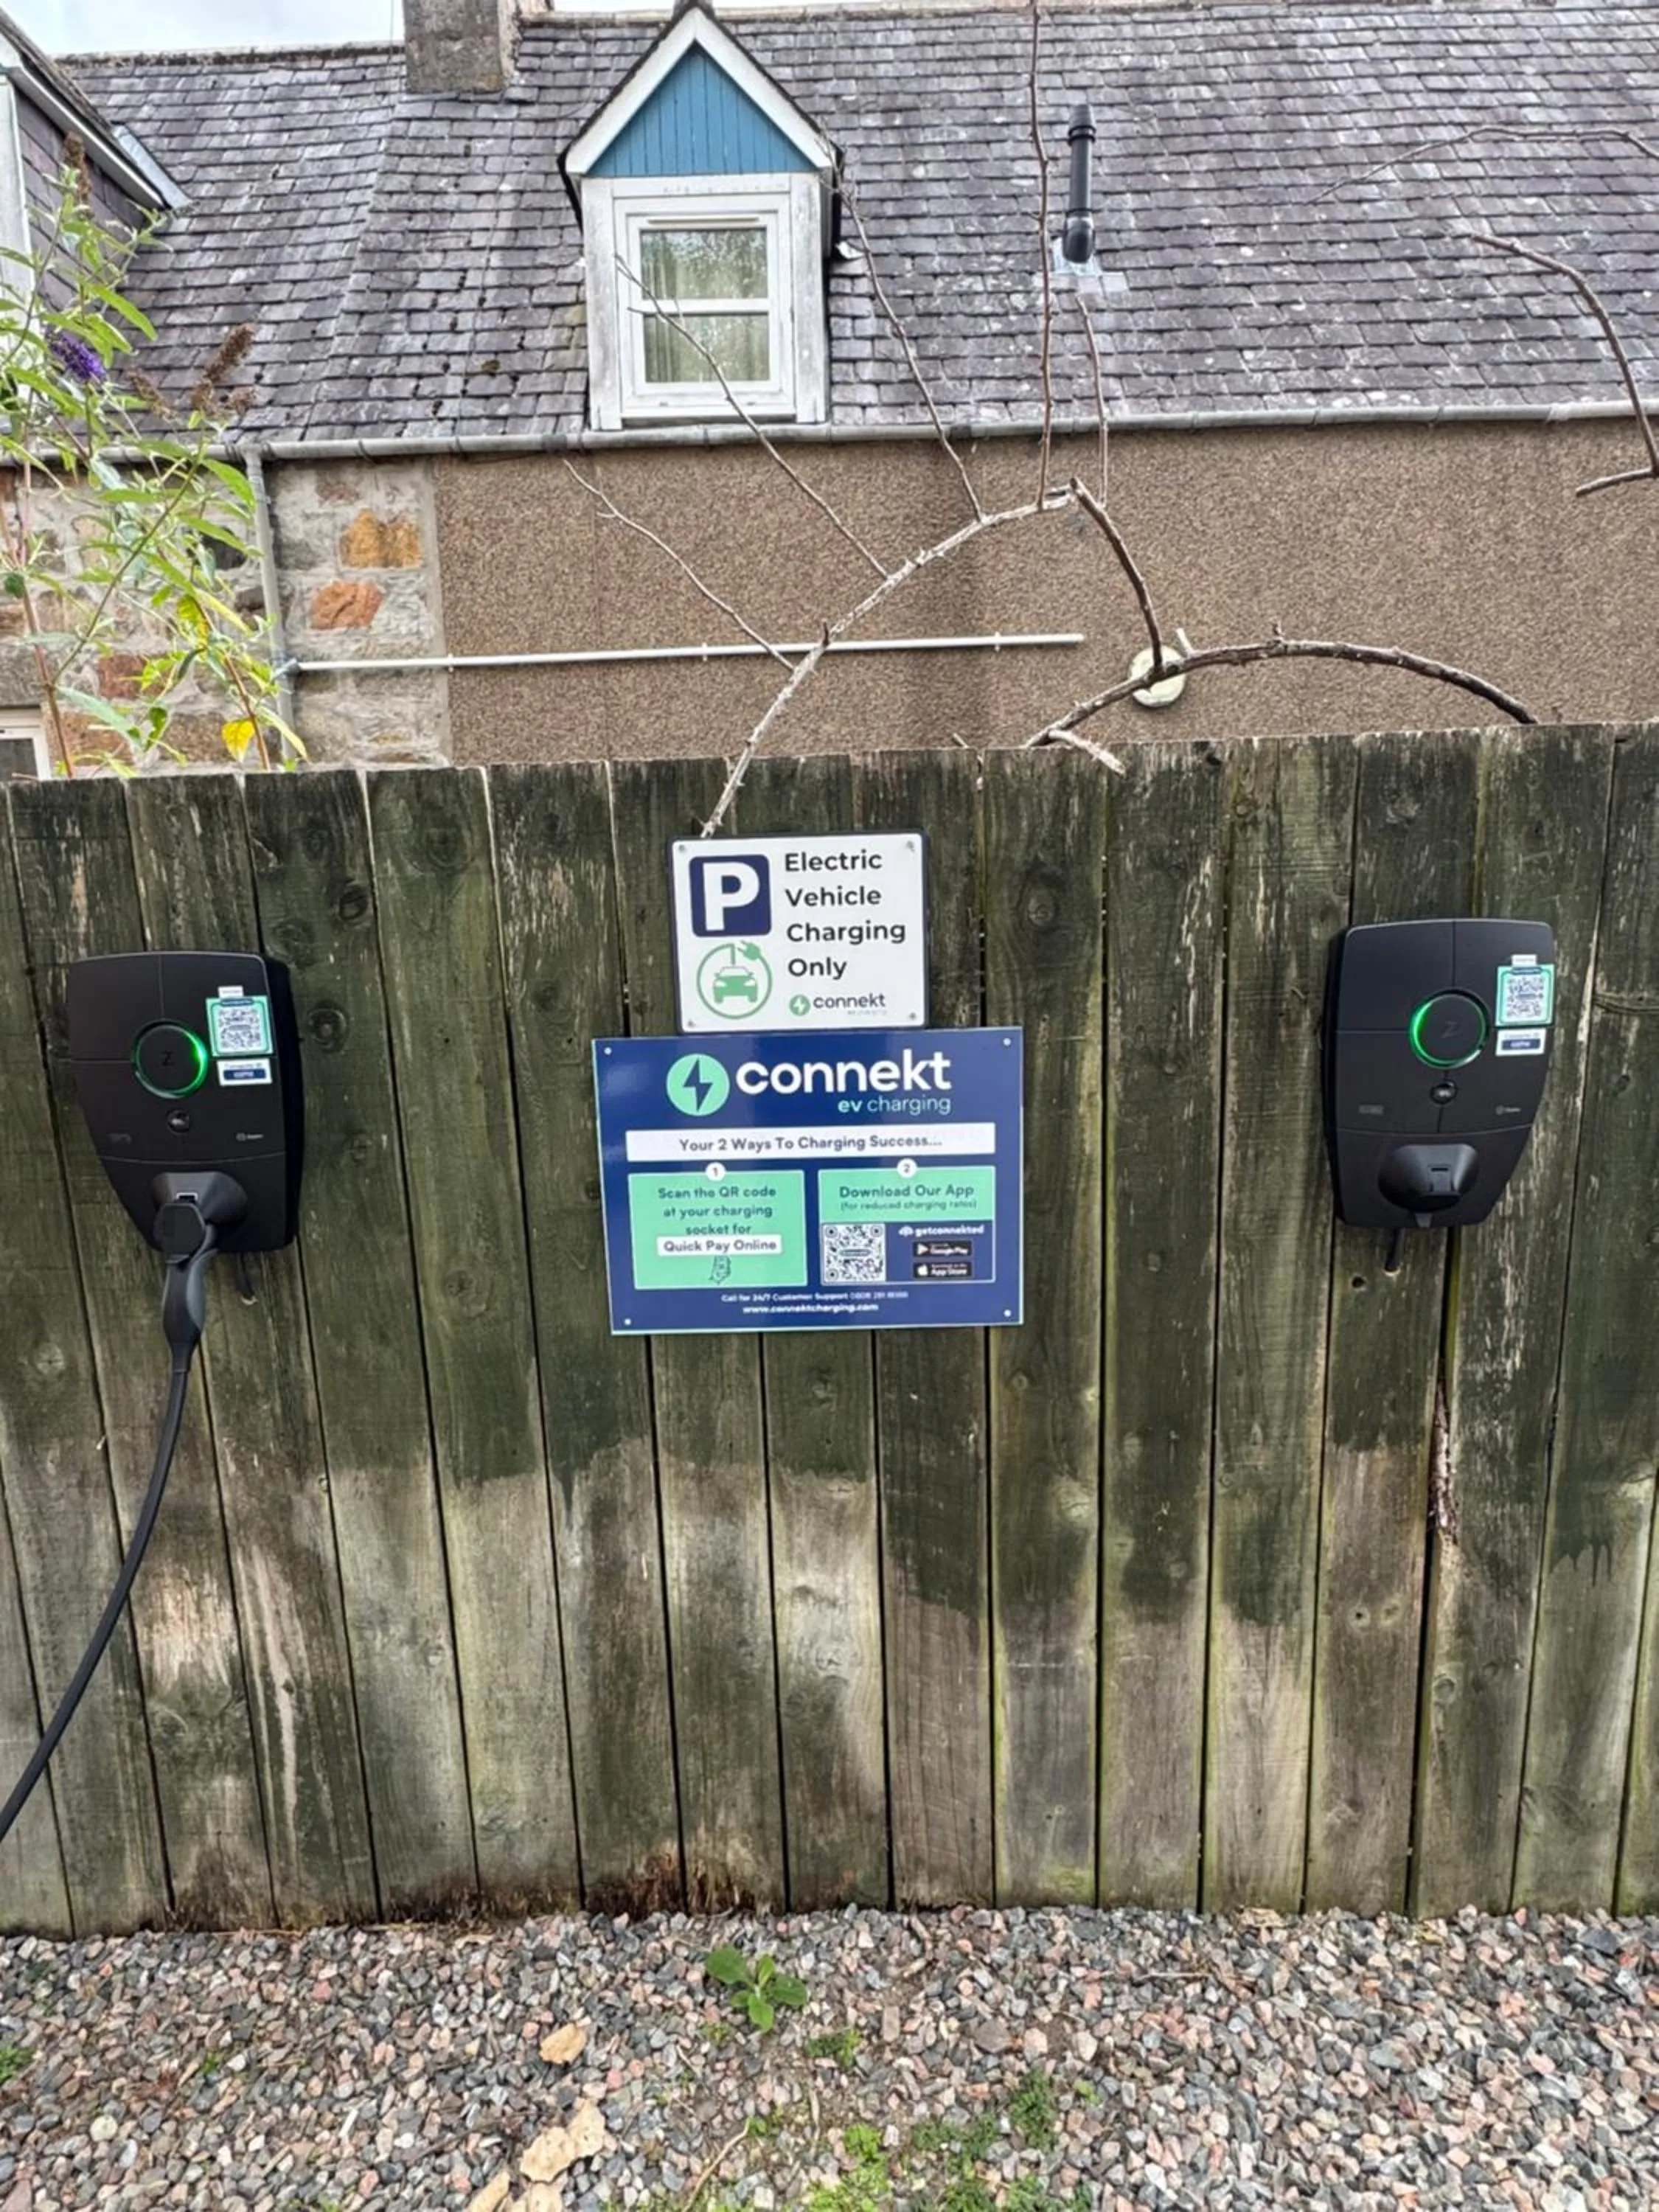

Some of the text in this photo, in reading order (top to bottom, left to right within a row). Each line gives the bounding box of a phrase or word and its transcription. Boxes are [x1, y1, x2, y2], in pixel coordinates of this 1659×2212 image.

[785, 849, 883, 872] Electric
[703, 862, 759, 931] P
[785, 886, 882, 907] Vehicle
[787, 920, 906, 945] Charging
[787, 957, 847, 979] Only
[813, 993, 886, 1009] connekt
[737, 1048, 951, 1094] connekt
[838, 1096, 951, 1116] ev charging
[679, 1134, 942, 1152] Your 2 Ways To Charging Success...
[712, 1167, 718, 1177] 1
[903, 1164, 910, 1173] 2
[658, 1186, 776, 1199] Scan the QR code
[839, 1183, 974, 1197] Download Our App
[664, 1205, 773, 1220] at your charging
[903, 1200, 947, 1211] charging
[686, 1222, 751, 1235] socket for
[664, 1239, 776, 1253] Quick Pay Online
